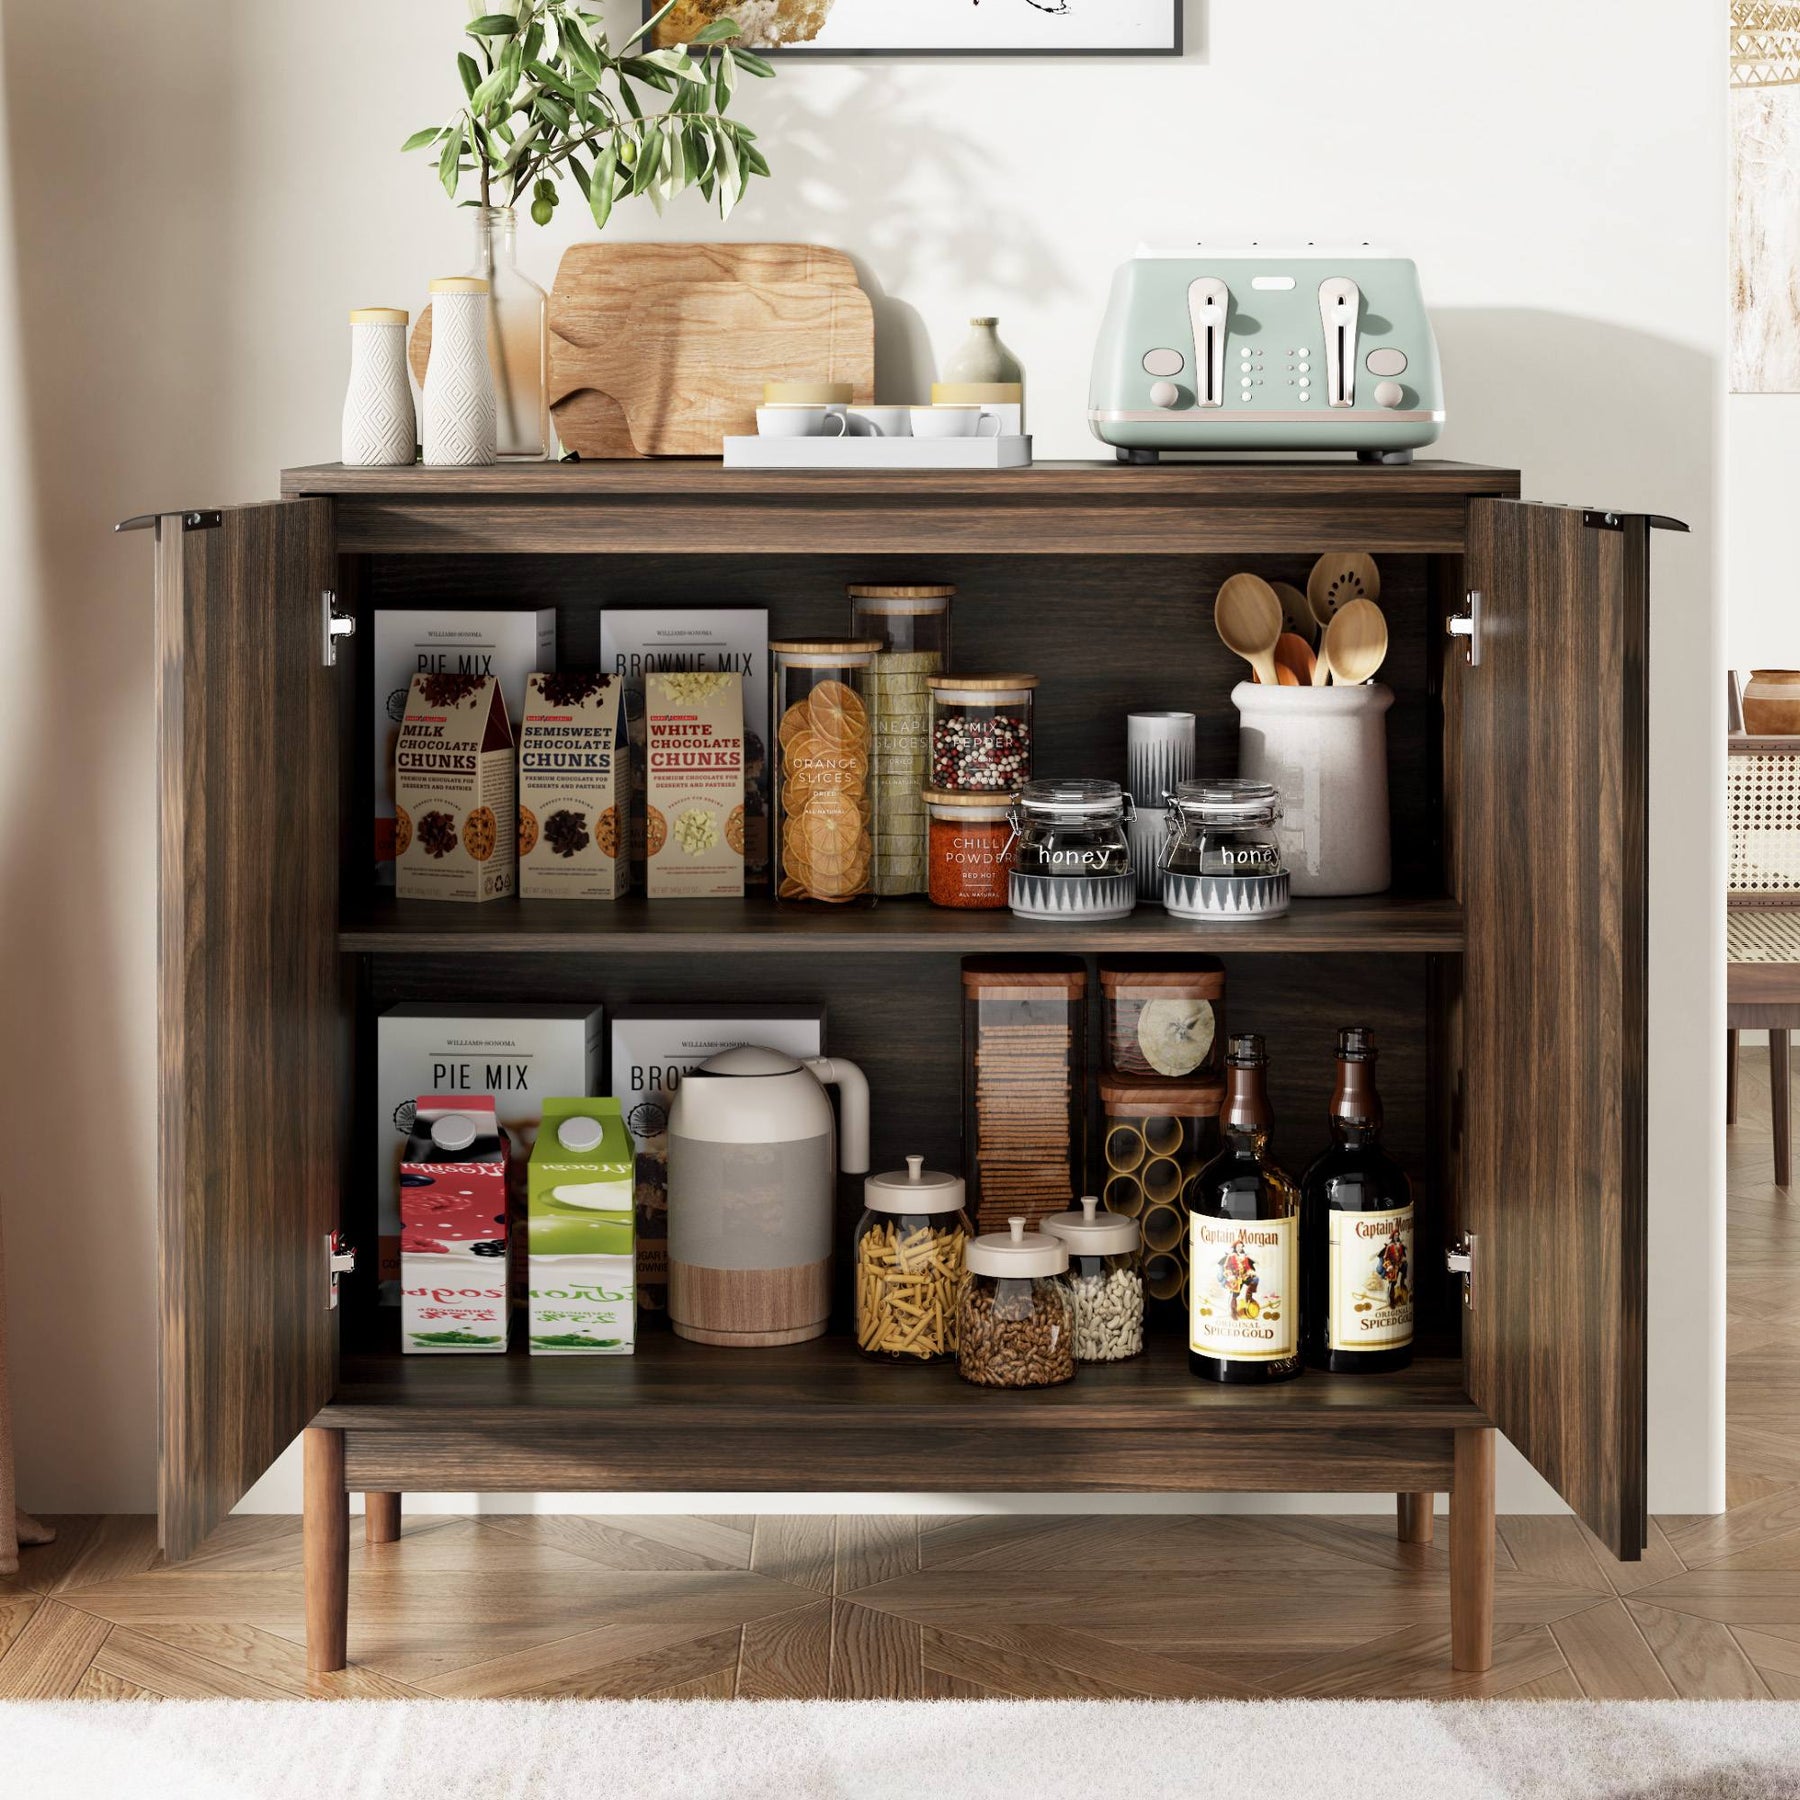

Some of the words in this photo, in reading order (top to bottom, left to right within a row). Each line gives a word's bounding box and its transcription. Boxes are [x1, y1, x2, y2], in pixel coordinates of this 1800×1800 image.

[459, 654, 493, 677] MIX
[616, 653, 707, 677] BROWNIE
[719, 653, 753, 677] MIX
[402, 725, 445, 738] MILK
[525, 727, 613, 737] SEMISWEET
[651, 724, 712, 736] WHITE
[969, 722, 997, 733] MIX
[400, 739, 478, 752] CHOCOLATE
[523, 739, 611, 750] CHOCOLATE
[651, 738, 741, 749] CHOCOLATE
[953, 737, 1013, 748] PEPPER
[398, 753, 477, 769] CHUNKS
[522, 753, 611, 768] CHUNKS
[651, 752, 741, 766] CHUNKS
[793, 758, 857, 769] ORANGE
[799, 772, 852, 783] SLICES
[953, 837, 1005, 849] CHILLI
[946, 852, 1012, 864] POWDER
[1039, 845, 1110, 870] honey
[1221, 846, 1280, 868] honey
[433, 1063, 471, 1089] PIE
[486, 1064, 529, 1090] MIX
[1355, 1218, 1394, 1240] Captain
[1200, 1225, 1235, 1245] Captain
[1238, 1228, 1279, 1248] Morgan
[1360, 1317, 1398, 1331] SPICED
[1204, 1324, 1240, 1337] SPICED
[1241, 1328, 1275, 1340] GOLD
